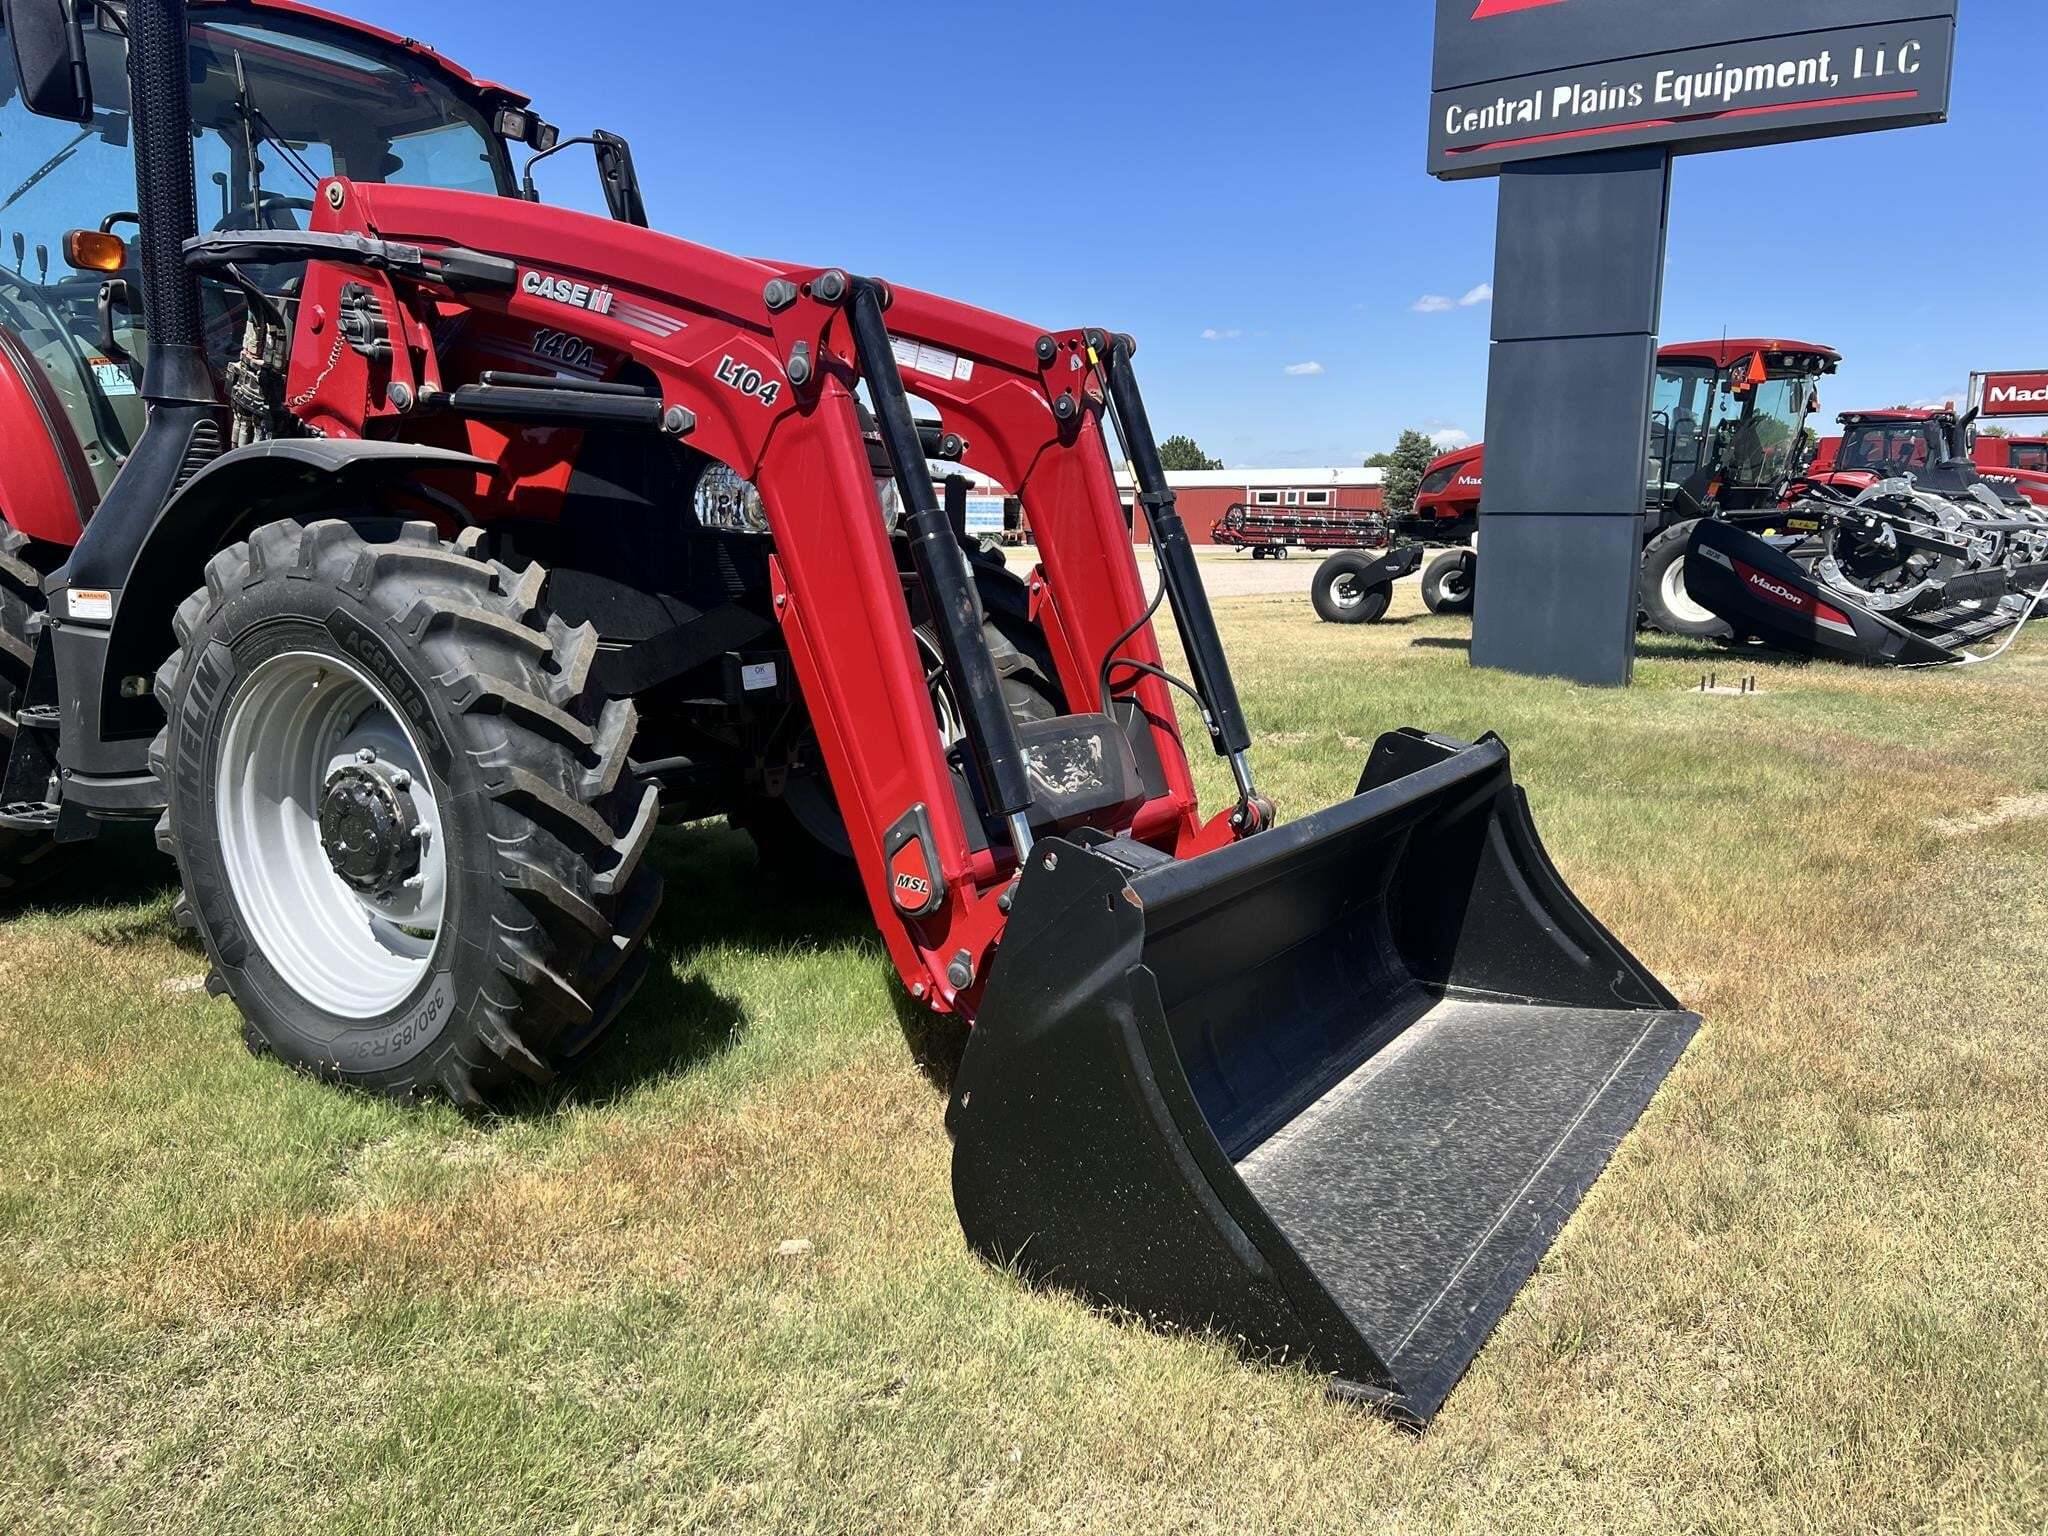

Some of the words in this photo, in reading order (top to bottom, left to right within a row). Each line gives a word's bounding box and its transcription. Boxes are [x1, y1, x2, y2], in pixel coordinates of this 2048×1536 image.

[1445, 90, 1543, 134] Central
[1551, 81, 1644, 118] Plains
[1653, 50, 1839, 107] Equipment,
[522, 271, 590, 308] CASE
[532, 328, 594, 368] 140A
[714, 354, 782, 408] L104
[1989, 384, 2048, 402] Mac
[1749, 574, 1802, 605] MacDon
[347, 631, 424, 720] AGRIBIB
[896, 873, 929, 894] MSL
[392, 987, 444, 1049] 380/85
